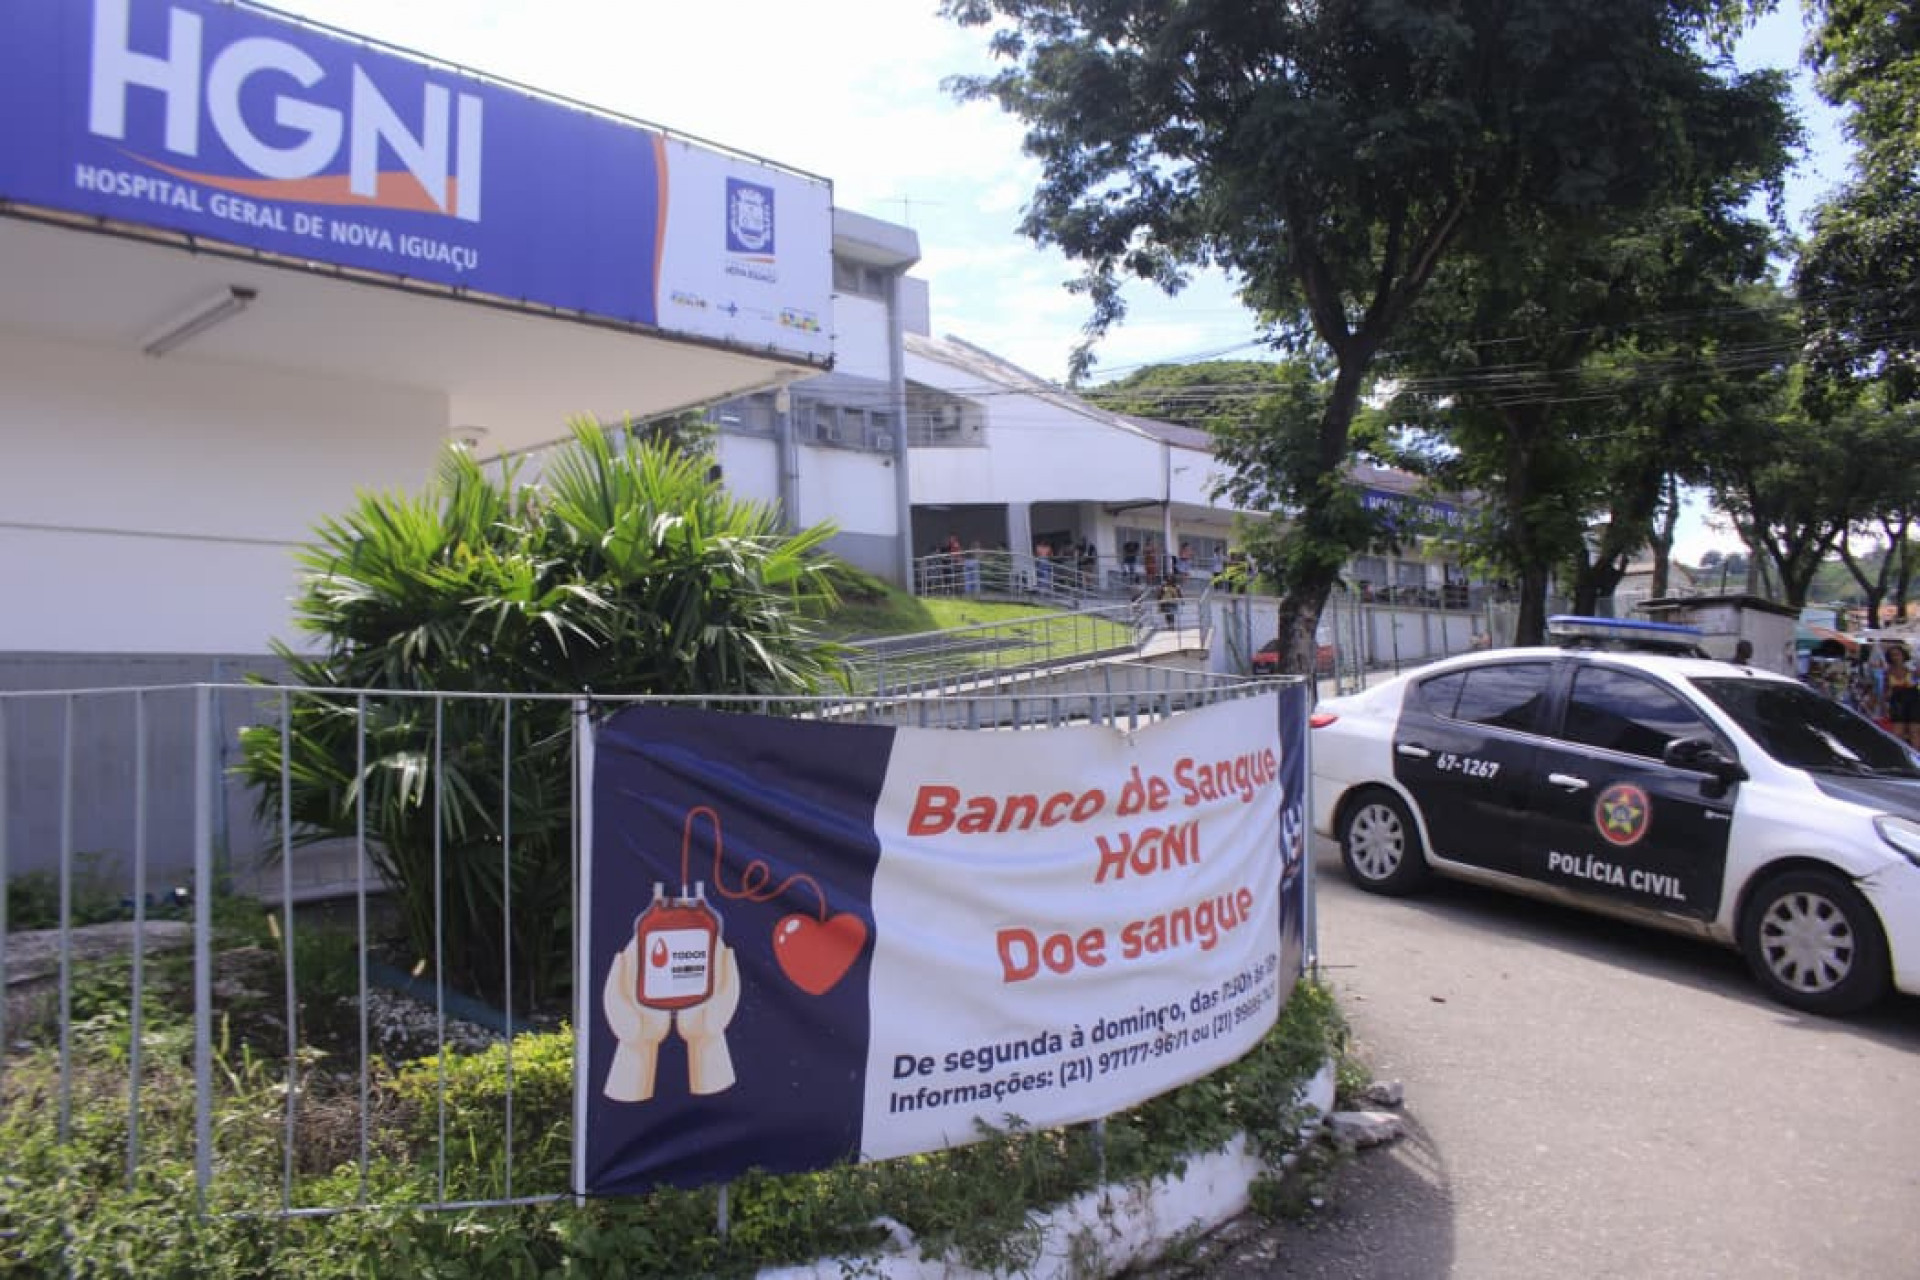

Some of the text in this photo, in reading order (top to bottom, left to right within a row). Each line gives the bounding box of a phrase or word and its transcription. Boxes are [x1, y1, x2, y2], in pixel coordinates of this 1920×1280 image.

[88, 0, 483, 222] HGNI
[75, 163, 478, 271] HOSPITAL GERAL DE NOVA IGUAÇU
[907, 747, 1278, 836] Banco de Sangue
[1436, 752, 1500, 779] 67-1267
[1093, 820, 1201, 884] HGNI
[1548, 850, 1686, 900] POLÍCIA CIVIL
[996, 886, 1253, 983] Doe sangue
[889, 1071, 1054, 1113] Informações:
[1059, 1056, 1093, 1088] (21)
[1192, 1023, 1210, 1043] ou
[893, 1053, 935, 1080] De
[944, 1029, 1063, 1074] segunda
[1070, 1024, 1085, 1049] à
[1190, 990, 1219, 1014] das
